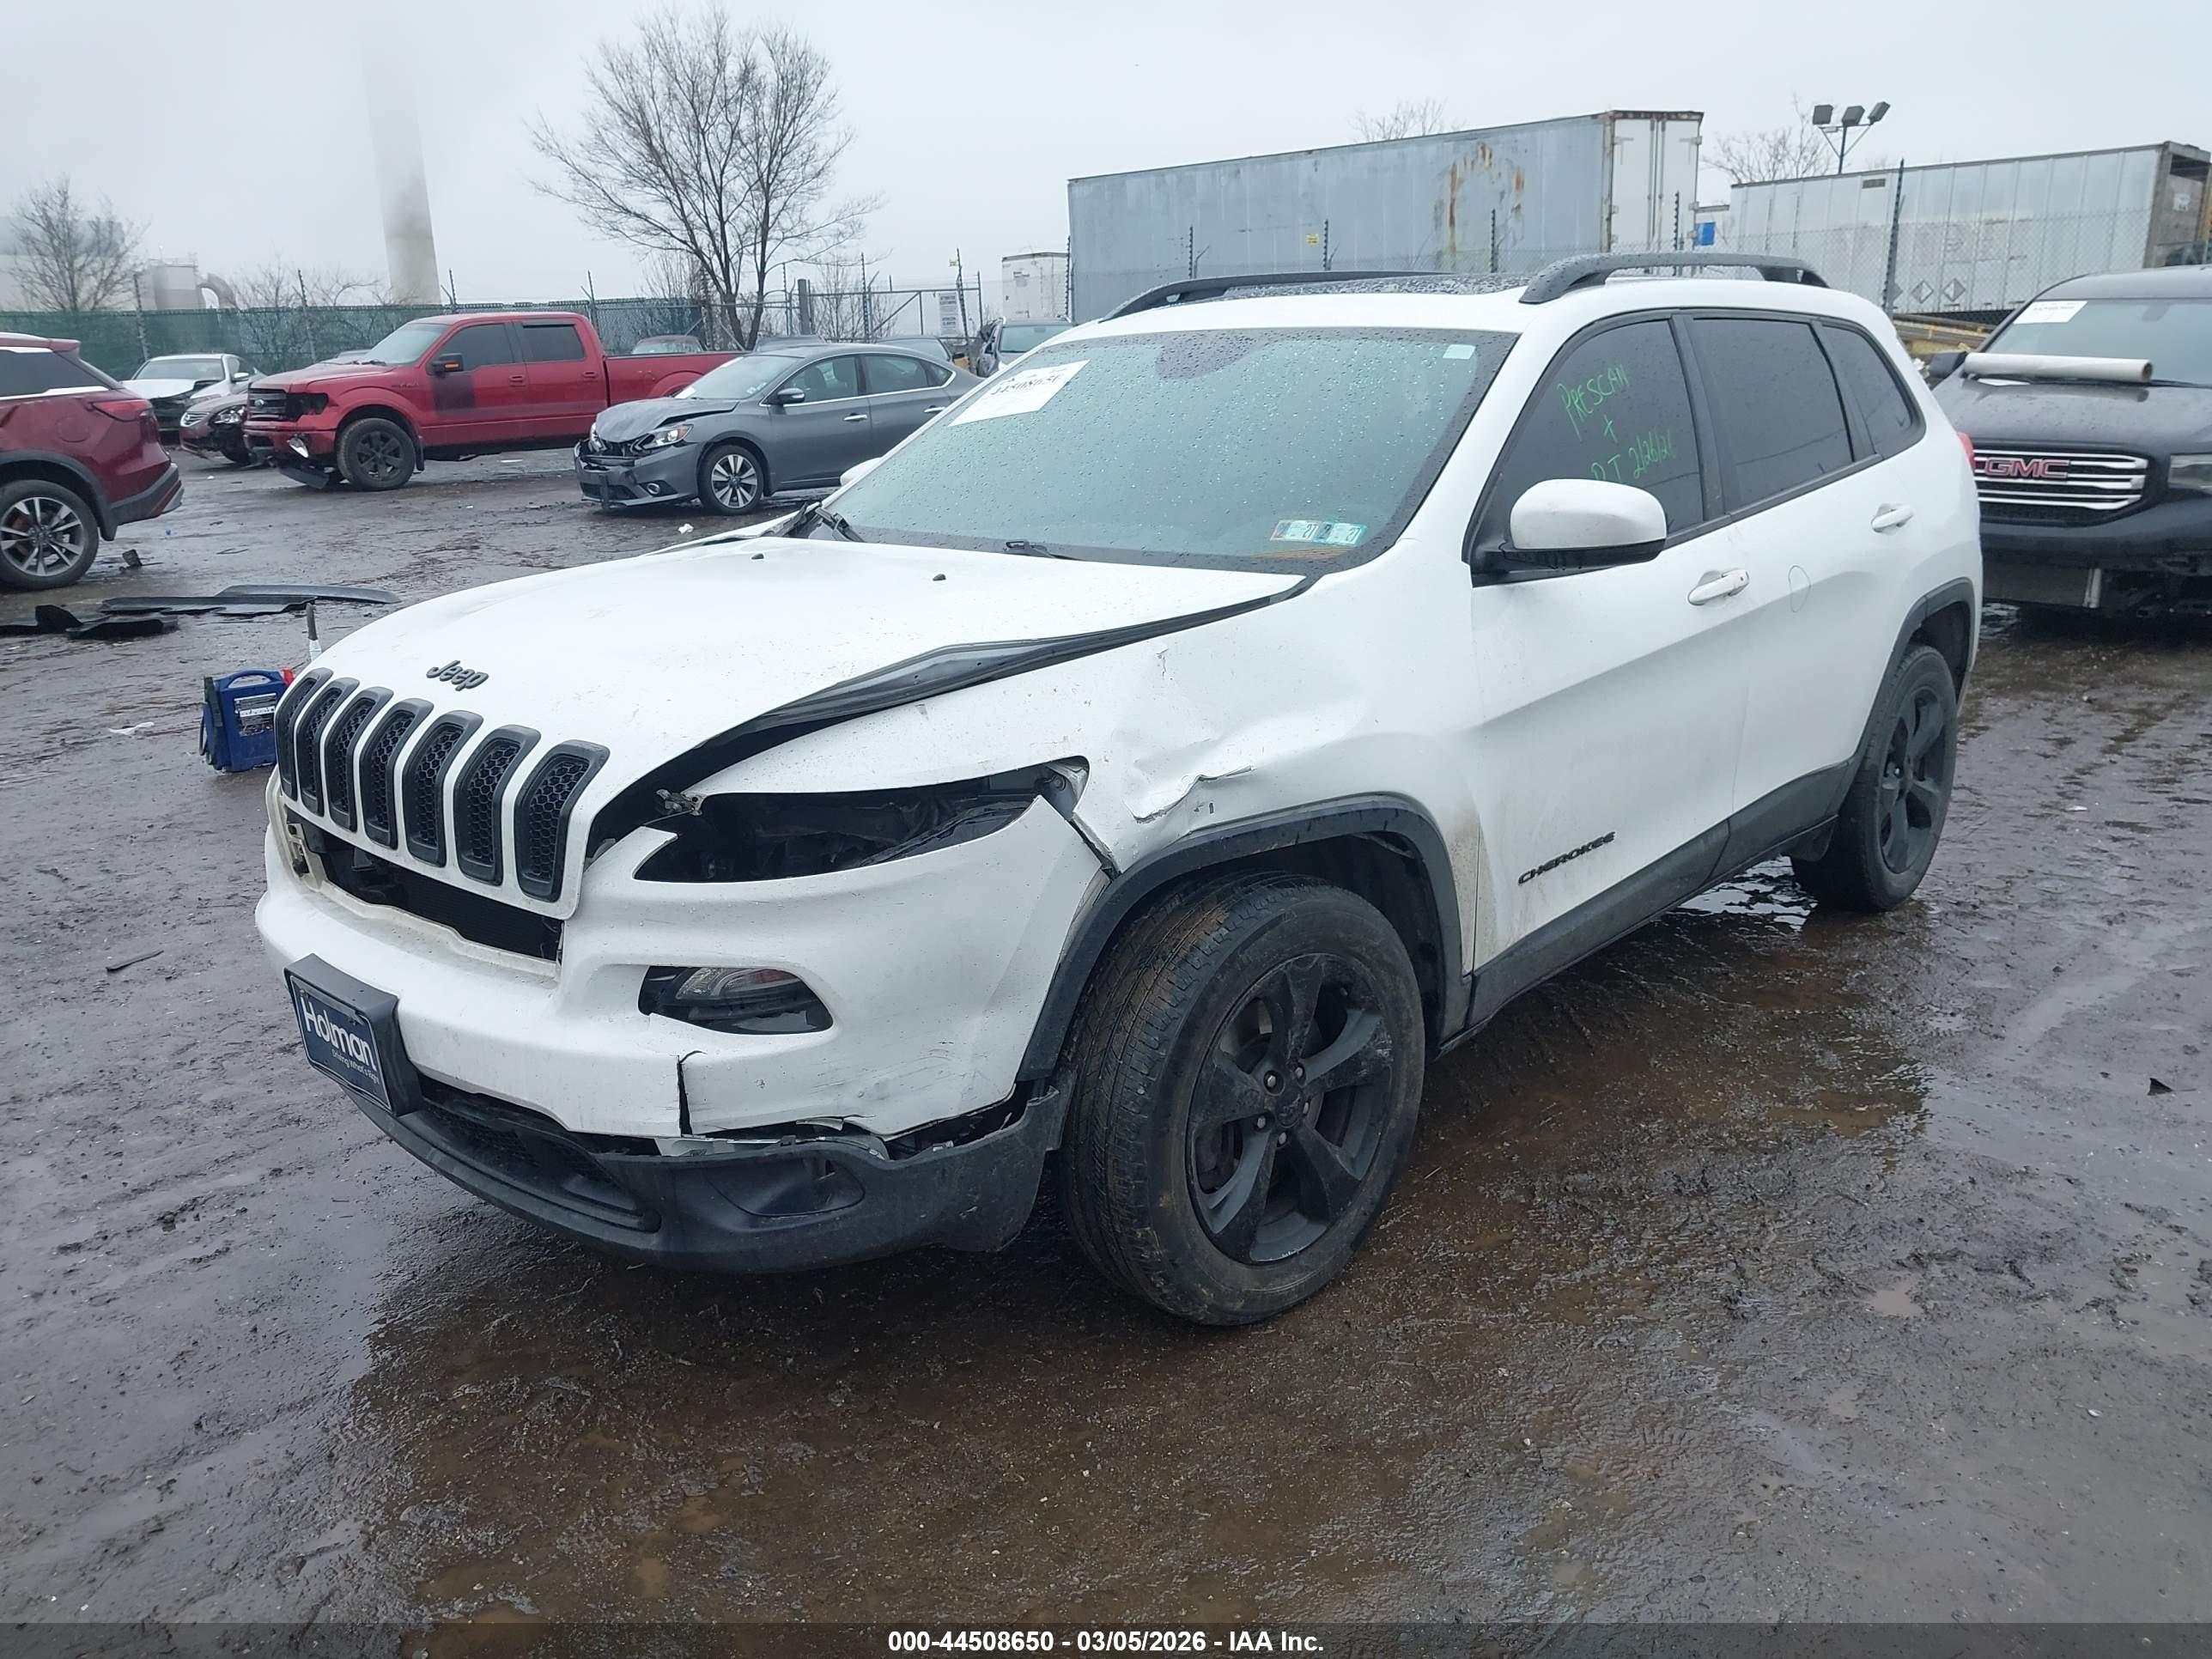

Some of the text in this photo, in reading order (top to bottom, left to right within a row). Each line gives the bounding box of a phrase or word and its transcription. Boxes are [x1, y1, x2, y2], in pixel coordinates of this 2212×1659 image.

[1556, 363, 1629, 442] PRESCAN
[1985, 458, 2069, 478] GMC
[426, 659, 489, 692] Jeep
[1517, 830, 1616, 885] CHEROKEE
[300, 996, 378, 1073] Holman
